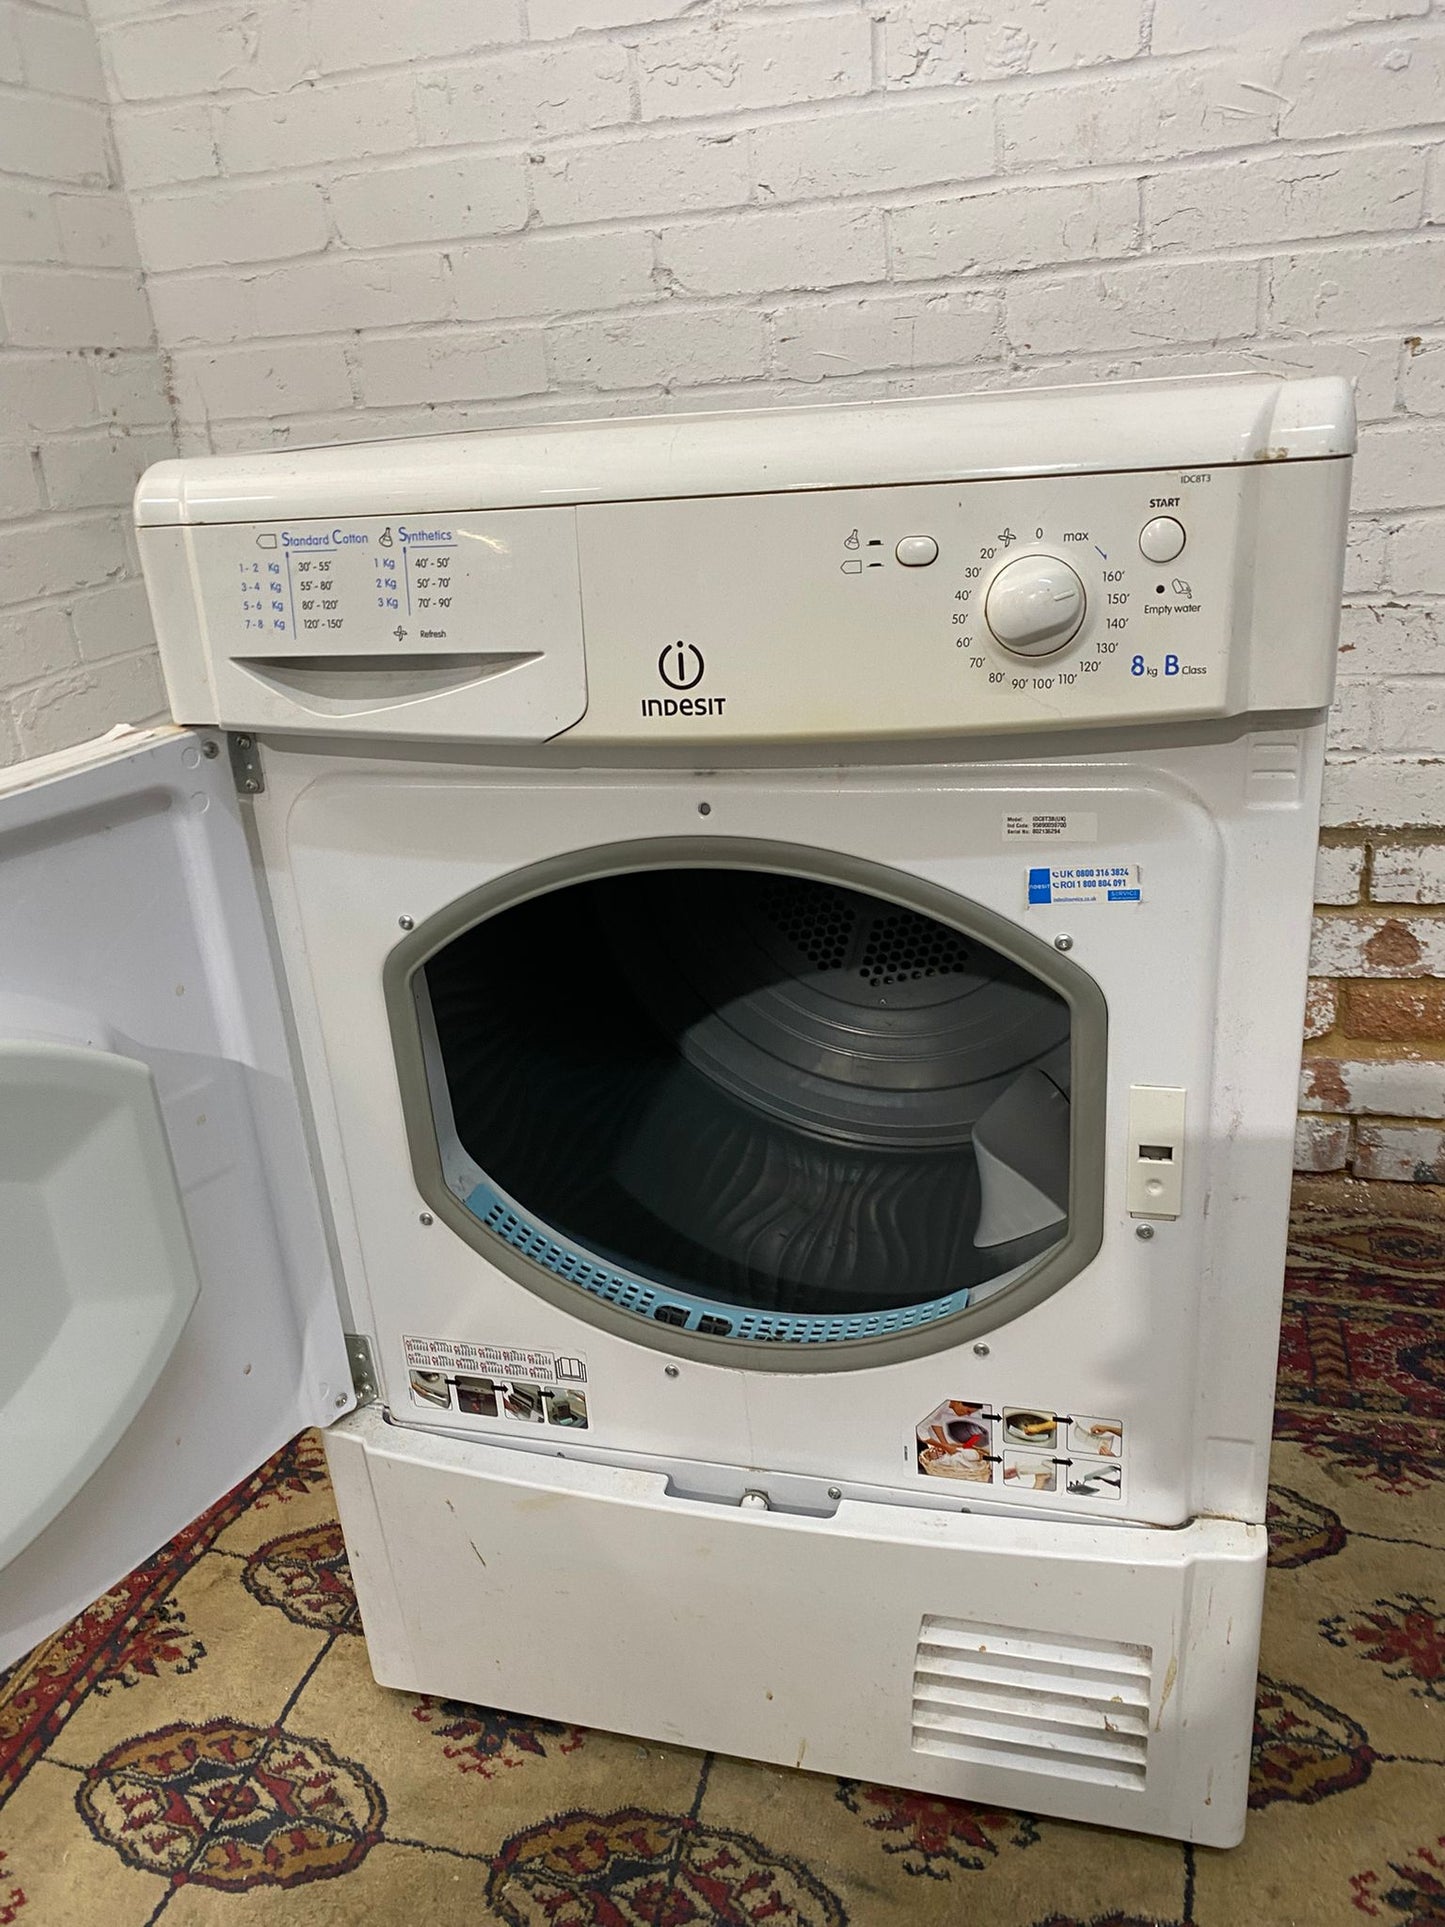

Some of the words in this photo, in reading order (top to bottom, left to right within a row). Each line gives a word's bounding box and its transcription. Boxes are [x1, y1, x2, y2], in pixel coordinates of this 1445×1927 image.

[1180, 474, 1211, 484] IDC8T3
[1149, 497, 1181, 508] START
[281, 532, 329, 547] Standard
[332, 529, 368, 544] Cotton
[398, 527, 452, 544] Synthetics
[1035, 528, 1043, 539] 0
[1063, 531, 1089, 542] max
[268, 562, 280, 574] Kg
[374, 558, 378, 567] 1
[382, 558, 395, 570] Kg
[270, 582, 282, 593] Kg
[376, 579, 383, 588] 2
[385, 578, 397, 590] Kg
[272, 601, 284, 612] Kg
[378, 598, 384, 607] 3
[386, 597, 399, 609] Kg
[1144, 604, 1173, 616] Empty
[1174, 603, 1201, 614] water
[273, 619, 286, 630] Kg
[420, 630, 447, 639] Refresh
[1130, 655, 1145, 677] 8
[1146, 665, 1158, 677] kg
[1164, 654, 1180, 676] B
[1182, 664, 1207, 675] Class
[1060, 870, 1074, 878] UK
[1076, 869, 1094, 878] 0800
[1096, 868, 1109, 877] 316
[1110, 867, 1129, 876] 3824
[1060, 880, 1075, 889] ROI
[1077, 880, 1081, 888] 1
[1082, 880, 1096, 888] 800
[1098, 880, 1111, 888] 804
[1113, 879, 1126, 887] 091
